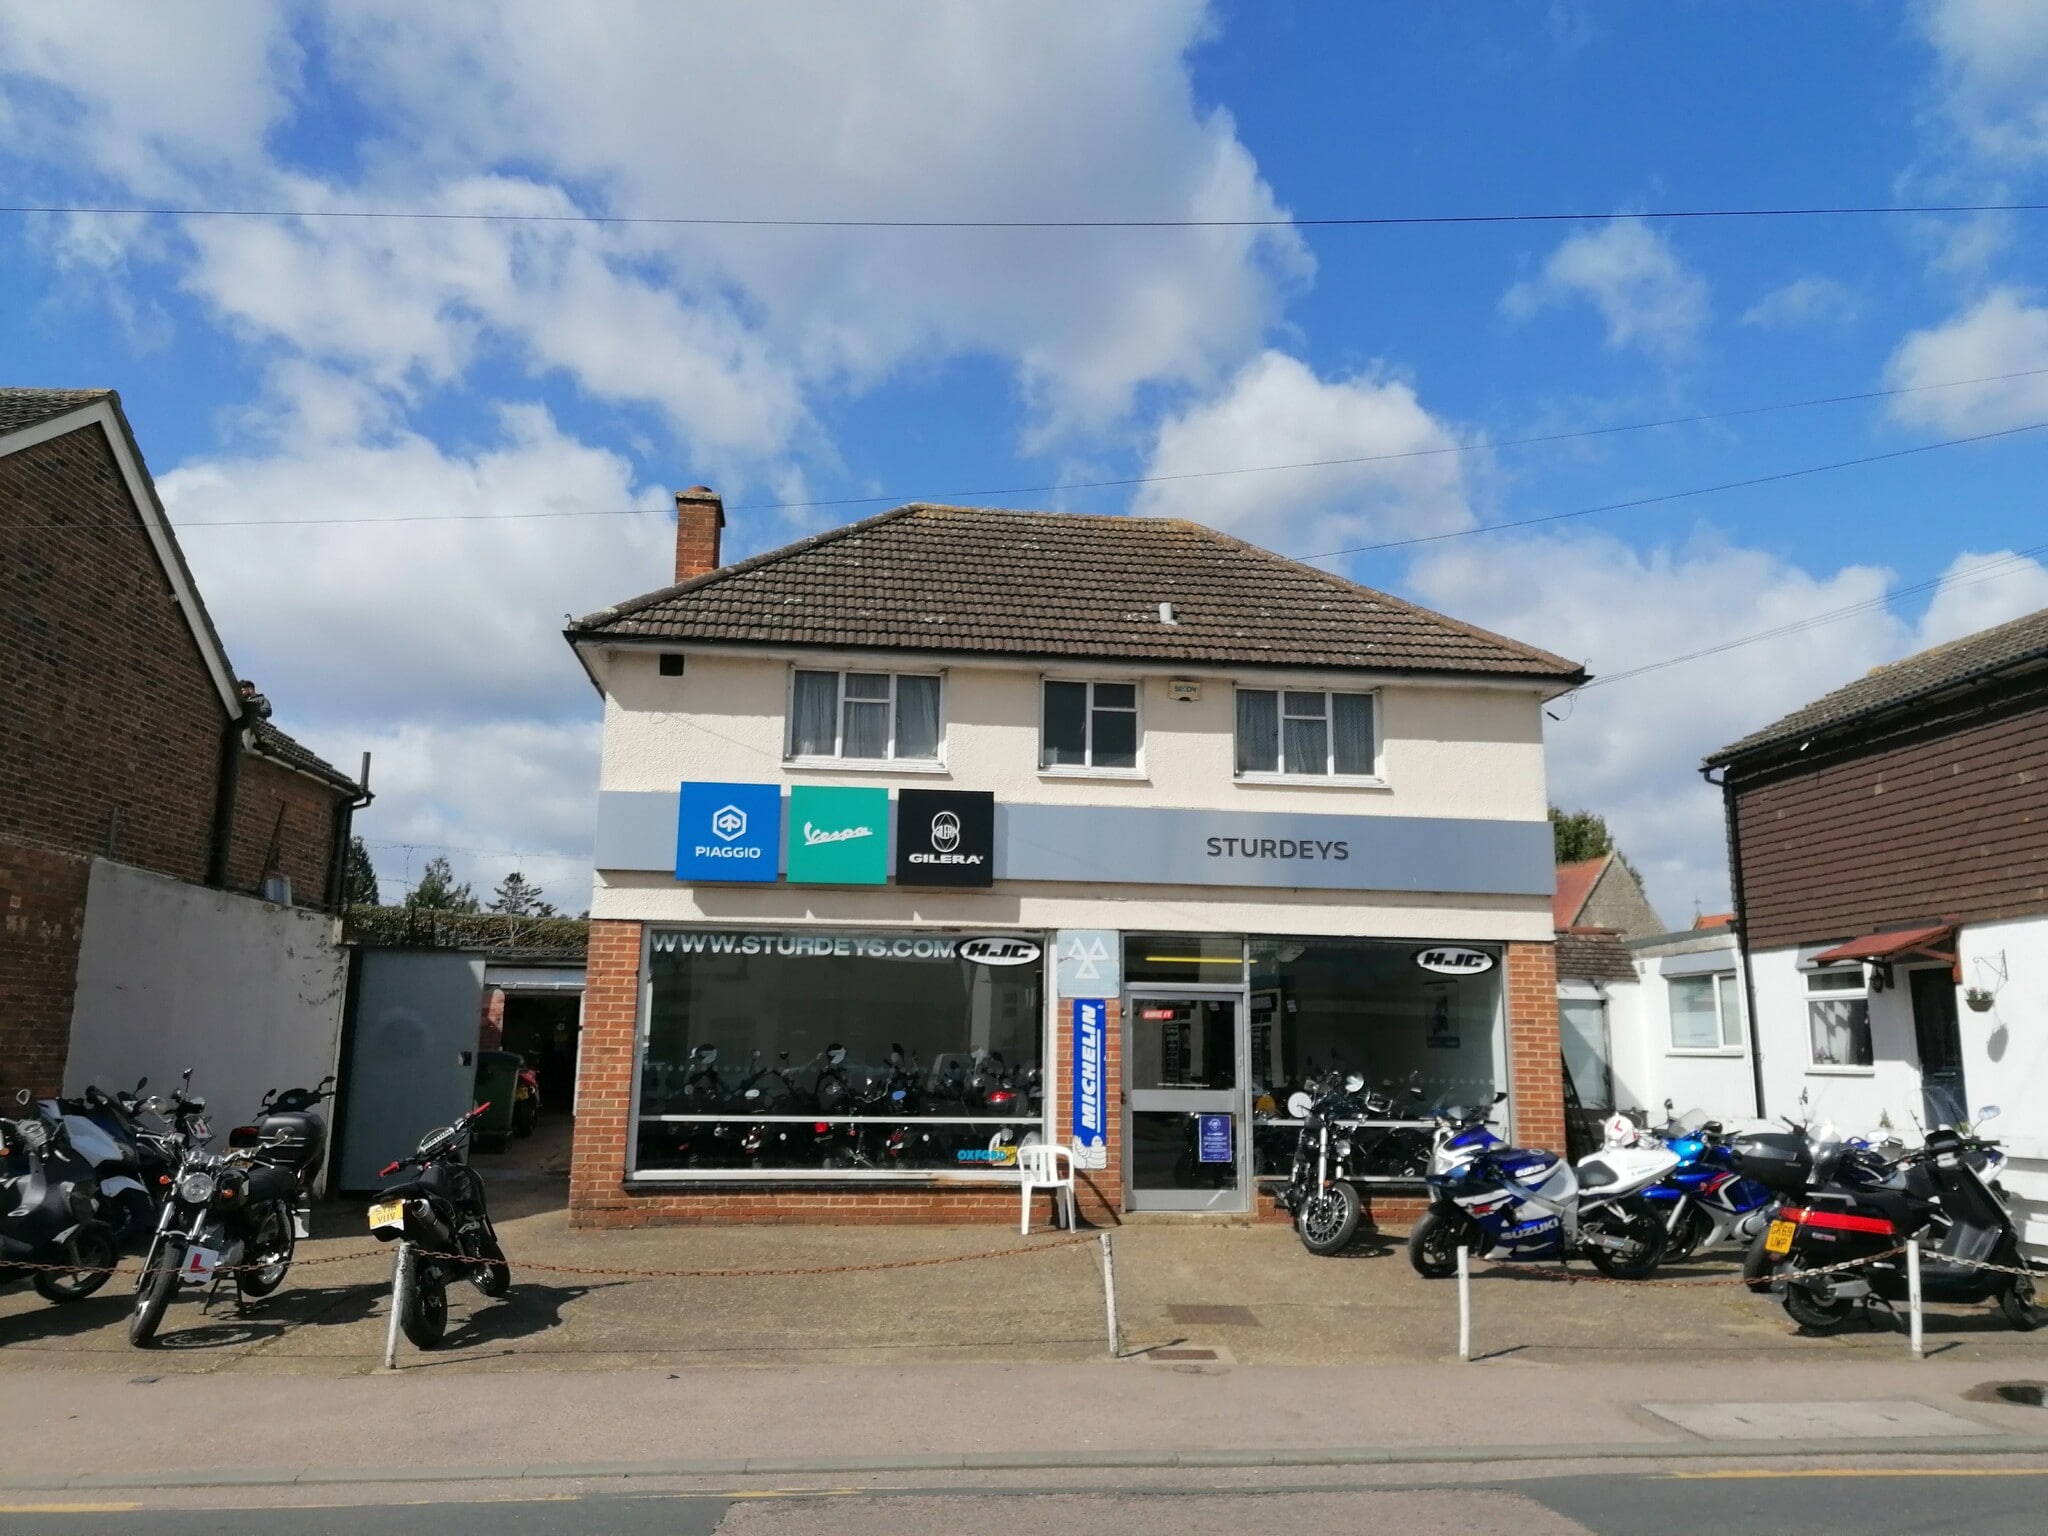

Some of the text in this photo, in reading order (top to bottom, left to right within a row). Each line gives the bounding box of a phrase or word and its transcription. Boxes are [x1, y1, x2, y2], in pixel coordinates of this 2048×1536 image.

[804, 821, 873, 846] Vespa
[695, 846, 762, 859] PIAGGIO
[1206, 837, 1349, 861] STURDEYS
[908, 853, 981, 865] GILERA
[652, 934, 957, 958] WWW.STURDEYS.COM
[966, 943, 1033, 958] HJC
[1423, 952, 1485, 967] HJC
[1082, 1004, 1096, 1130] MICHELIN
[957, 1149, 1007, 1161] OXFORD
[1500, 1217, 1560, 1240] SUZUKI
